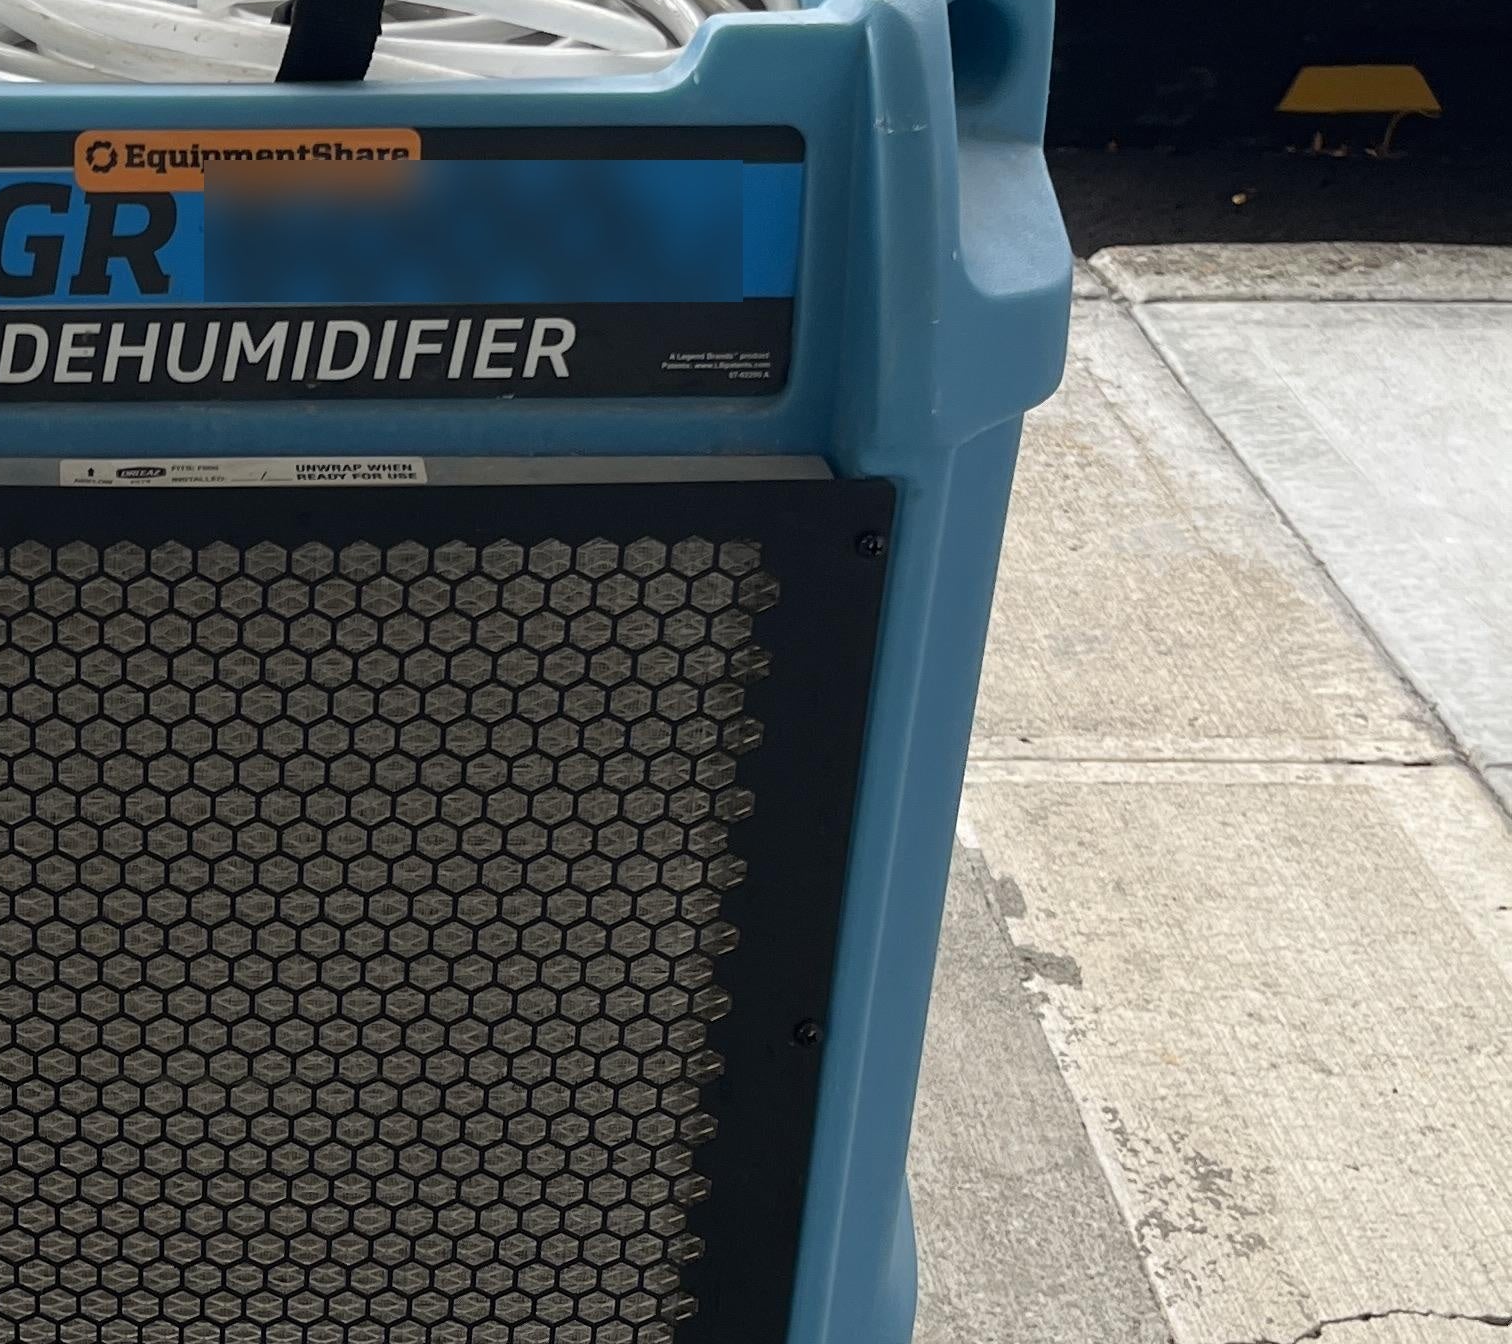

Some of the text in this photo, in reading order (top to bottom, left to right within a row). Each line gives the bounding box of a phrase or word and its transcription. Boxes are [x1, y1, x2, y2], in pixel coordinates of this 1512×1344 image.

[295, 463, 413, 473] UNWRAP WHEN
[296, 472, 417, 481] READY FOR USE
